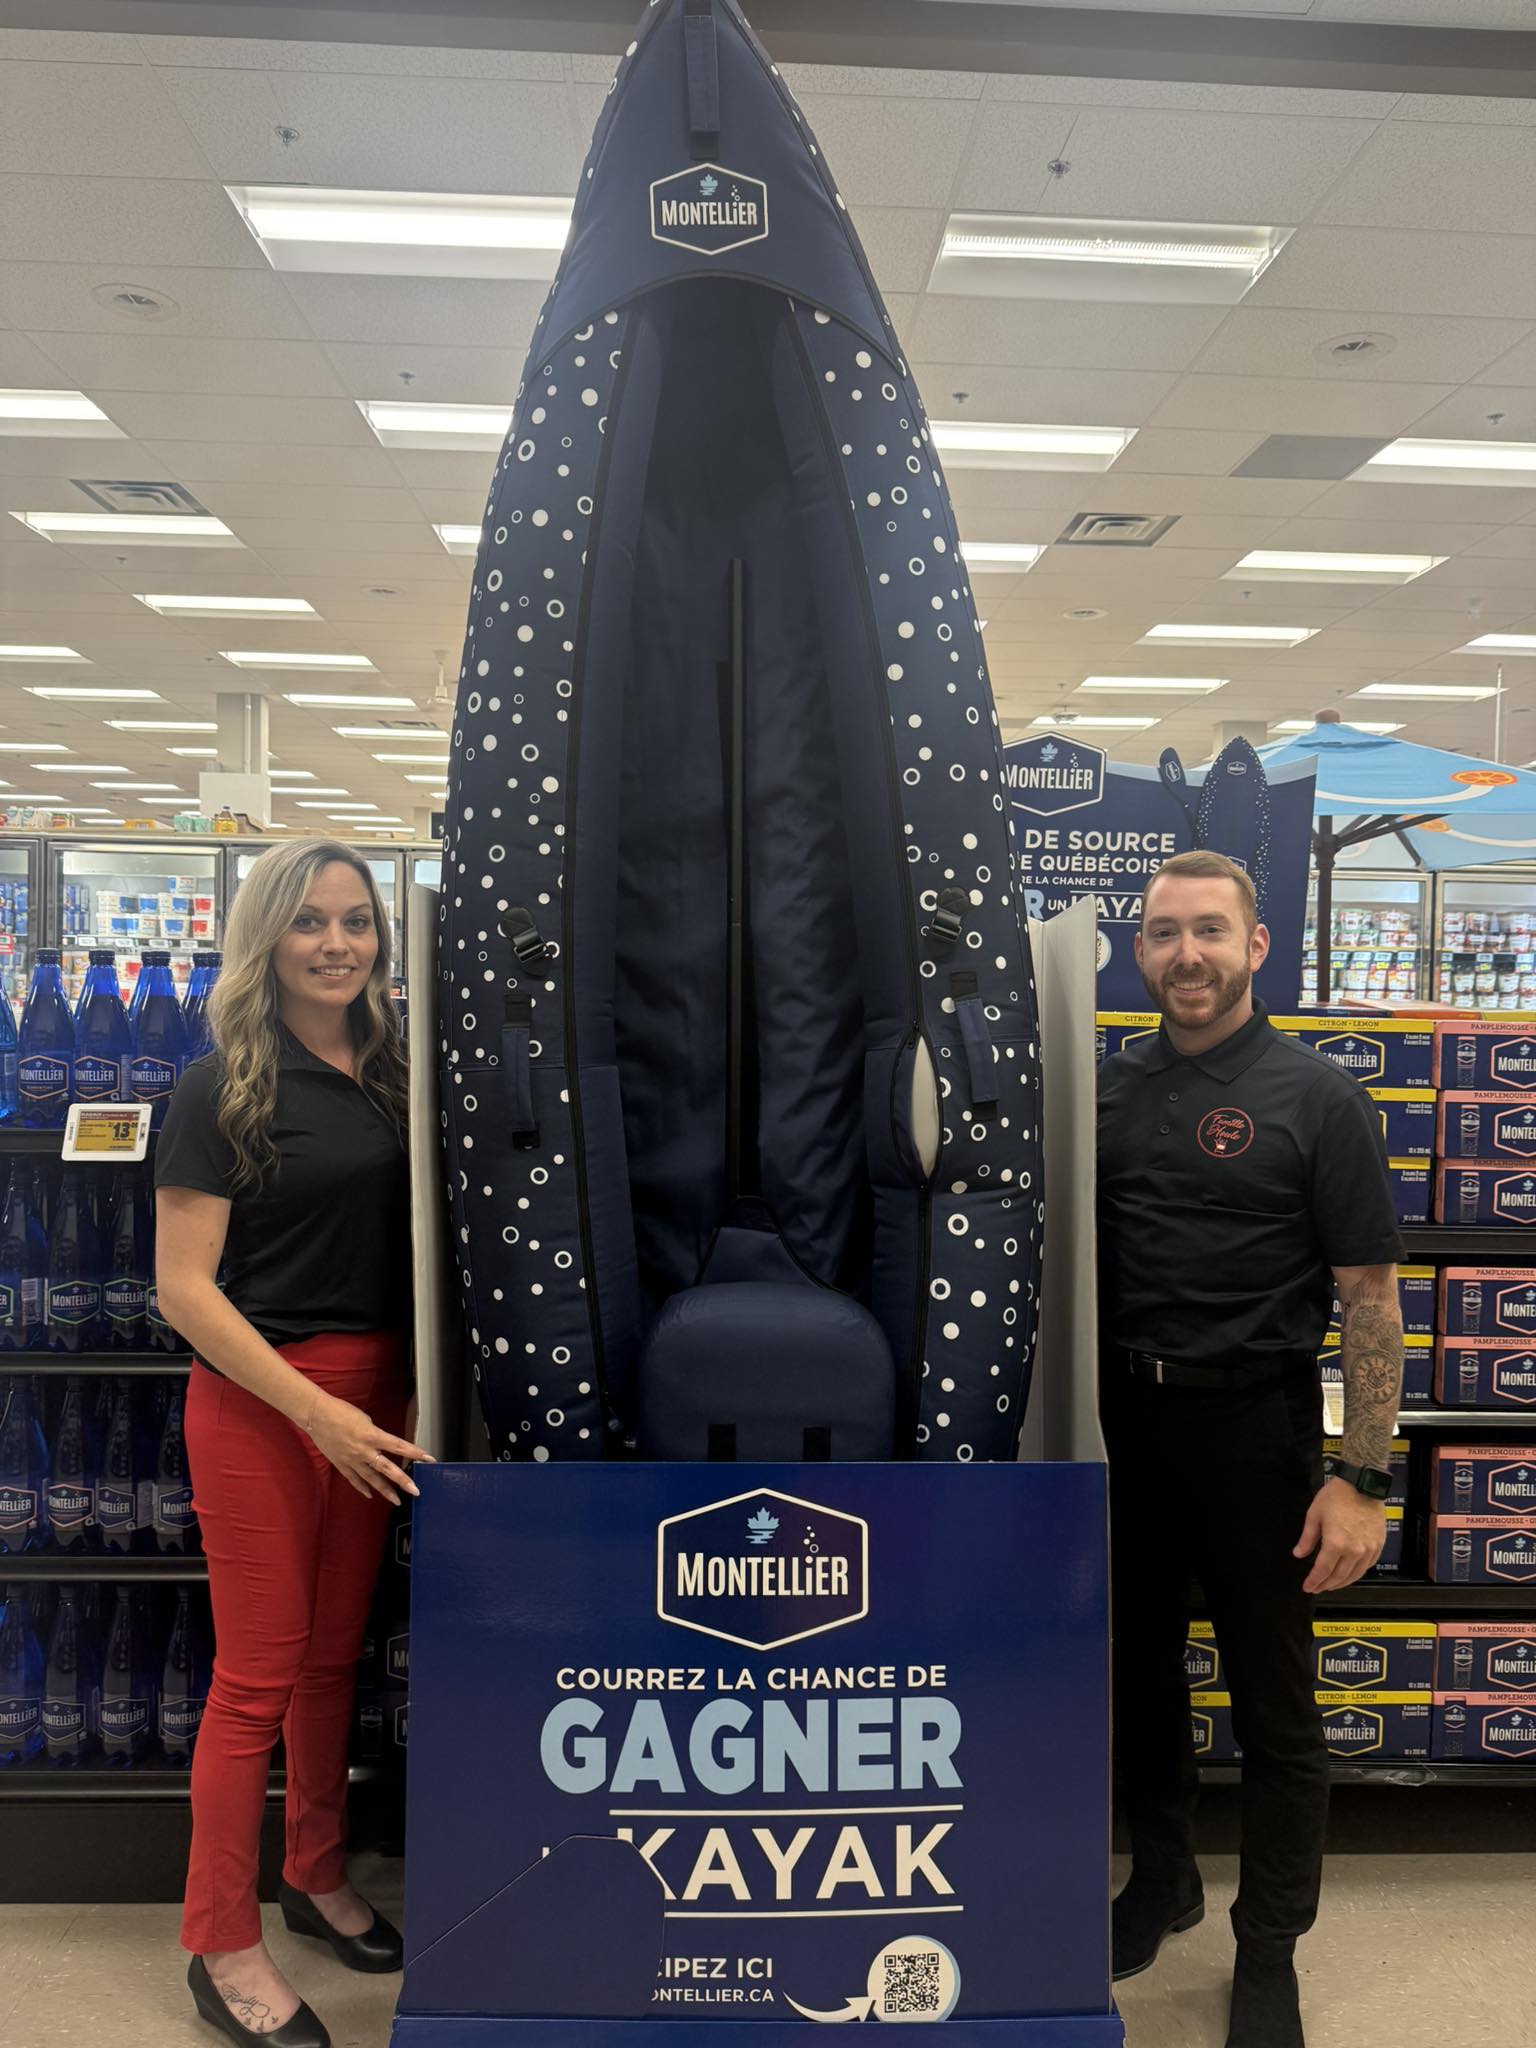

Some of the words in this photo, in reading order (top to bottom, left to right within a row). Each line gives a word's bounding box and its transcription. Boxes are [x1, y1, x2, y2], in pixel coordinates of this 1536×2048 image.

[1025, 829, 1060, 850] DE
[1068, 830, 1176, 853] SOURCE
[1040, 852, 1167, 874] QUÉBÉCOIS
[1035, 876, 1049, 885] LA
[1052, 877, 1096, 887] CHANCE
[1099, 878, 1114, 887] DE
[1048, 899, 1067, 911] UN
[1071, 895, 1143, 919] AYA
[1125, 1015, 1154, 1023] CITRON
[1471, 1023, 1529, 1031] PAMPLEMOUSSE
[1322, 1053, 1378, 1068] ONTELLiER
[1498, 1056, 1536, 1072] MONTELL
[1501, 1125, 1536, 1140] MONTEL
[1501, 1192, 1536, 1207] MONTEL
[1476, 1269, 1535, 1277] PAMPLEMOUSSE
[1504, 1302, 1536, 1318] MONTE
[1473, 1338, 1532, 1346] PAMPLEMOUSSE
[1500, 1371, 1536, 1386] MONTEL
[1468, 1448, 1526, 1456] PAMPLEMOUSSE
[1321, 1625, 1350, 1633] CITRON
[1356, 1625, 1382, 1633] LEMON
[555, 1667, 706, 1690] COURREZ
[717, 1668, 757, 1690] LA
[767, 1666, 896, 1689] CHANCE
[907, 1664, 947, 1687] DE
[1317, 1692, 1346, 1700] CITRON
[1351, 1692, 1378, 1700] LEMON
[540, 1696, 964, 1795] GAGNER
[737, 1957, 773, 1979] ICI
